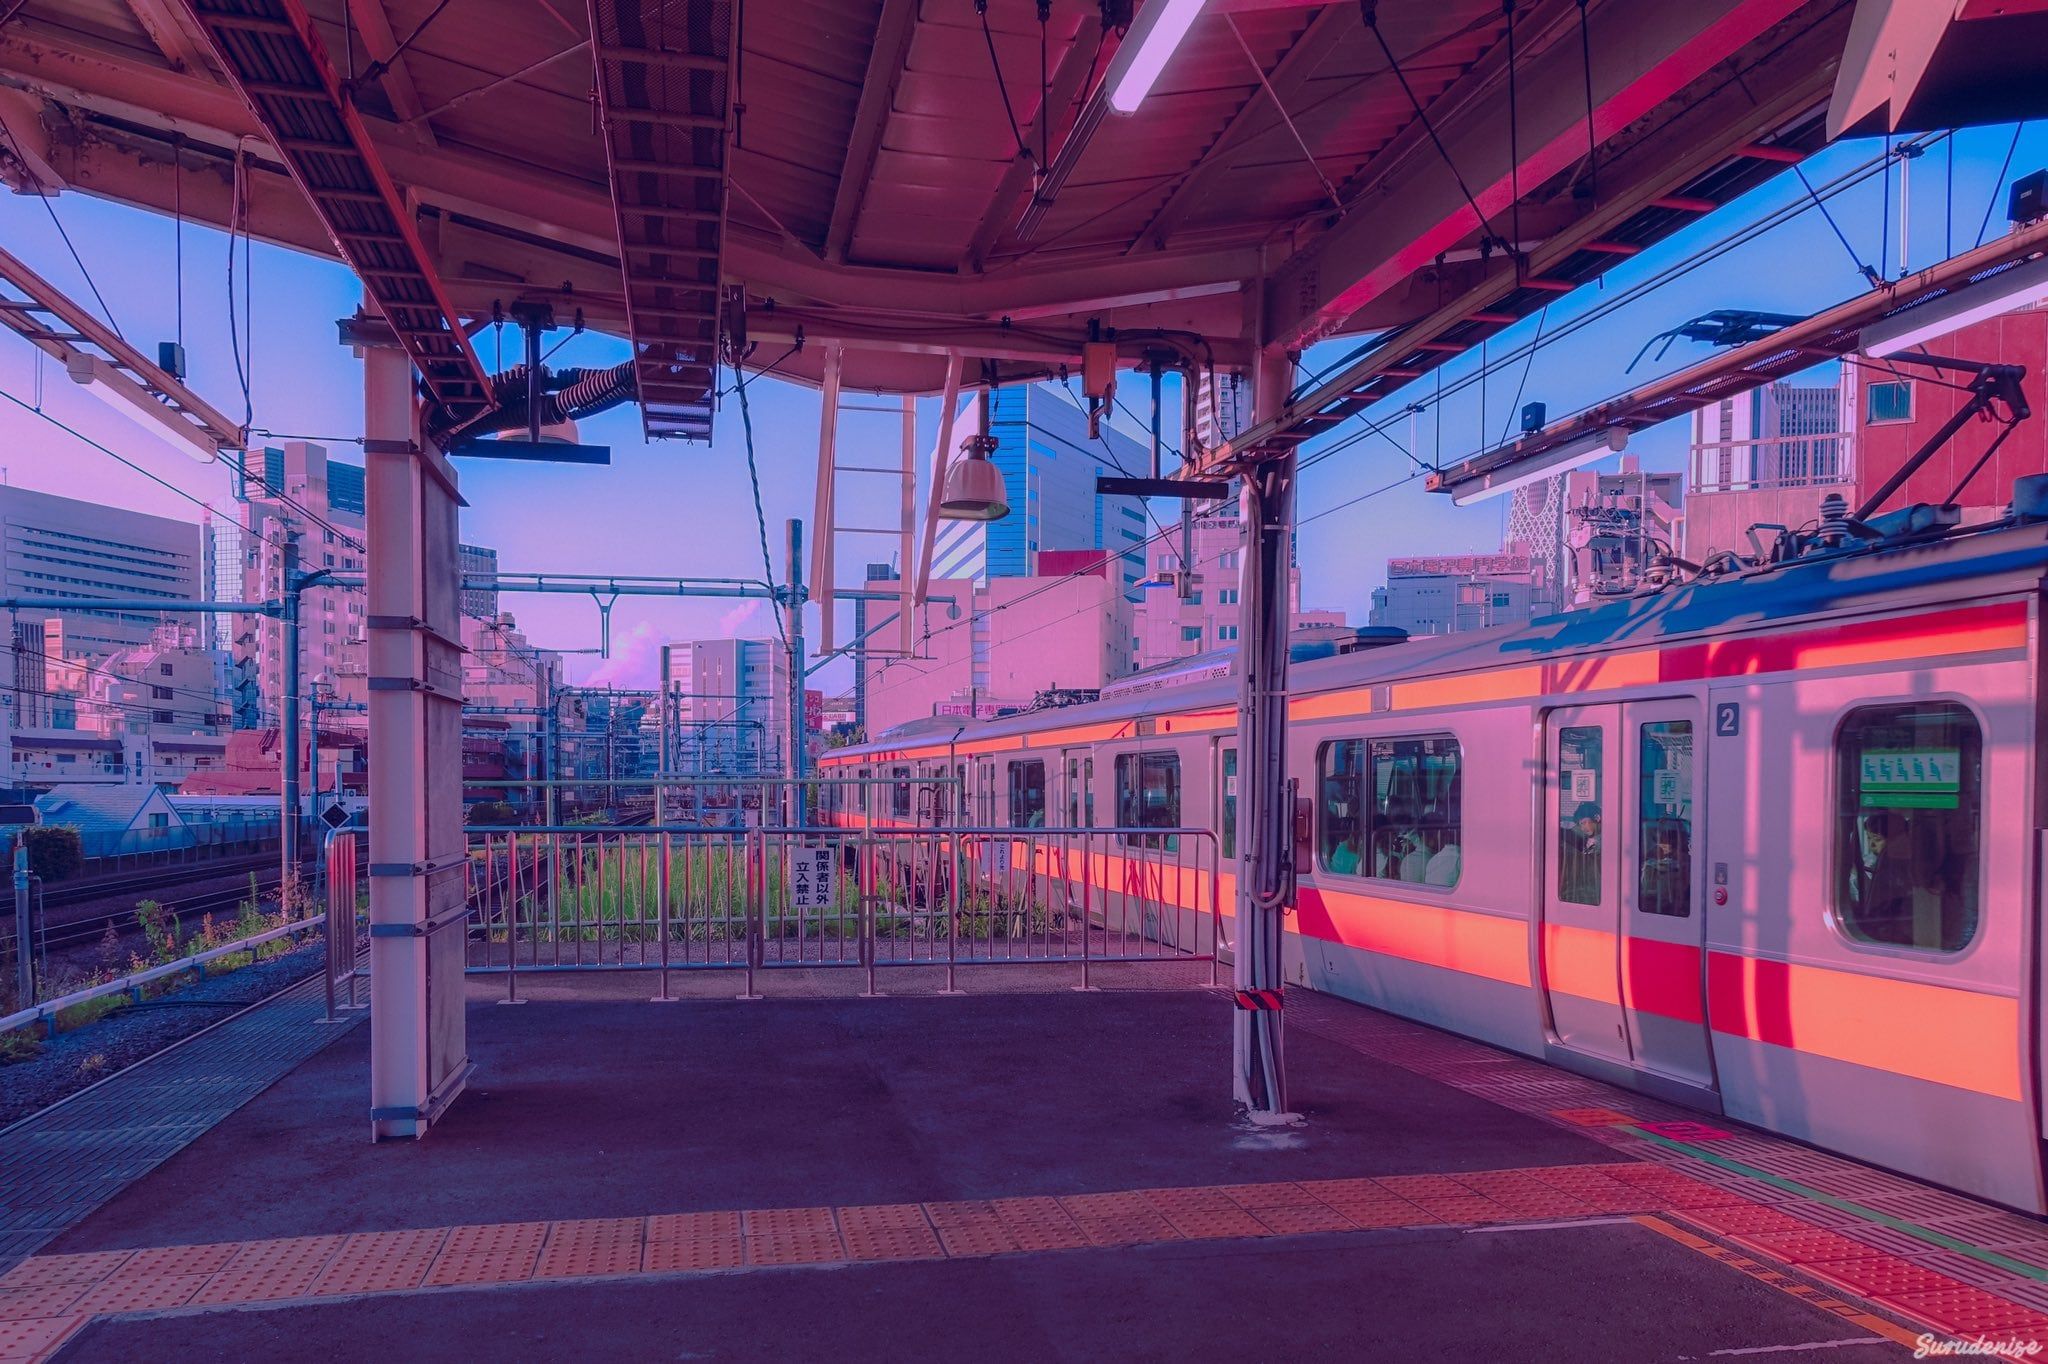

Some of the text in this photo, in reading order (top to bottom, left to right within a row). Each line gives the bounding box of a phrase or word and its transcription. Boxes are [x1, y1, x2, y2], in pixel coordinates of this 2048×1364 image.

[1721, 708, 1735, 731] 2
[796, 862, 809, 905] 立入禁止
[816, 850, 830, 904] 関係者以外
